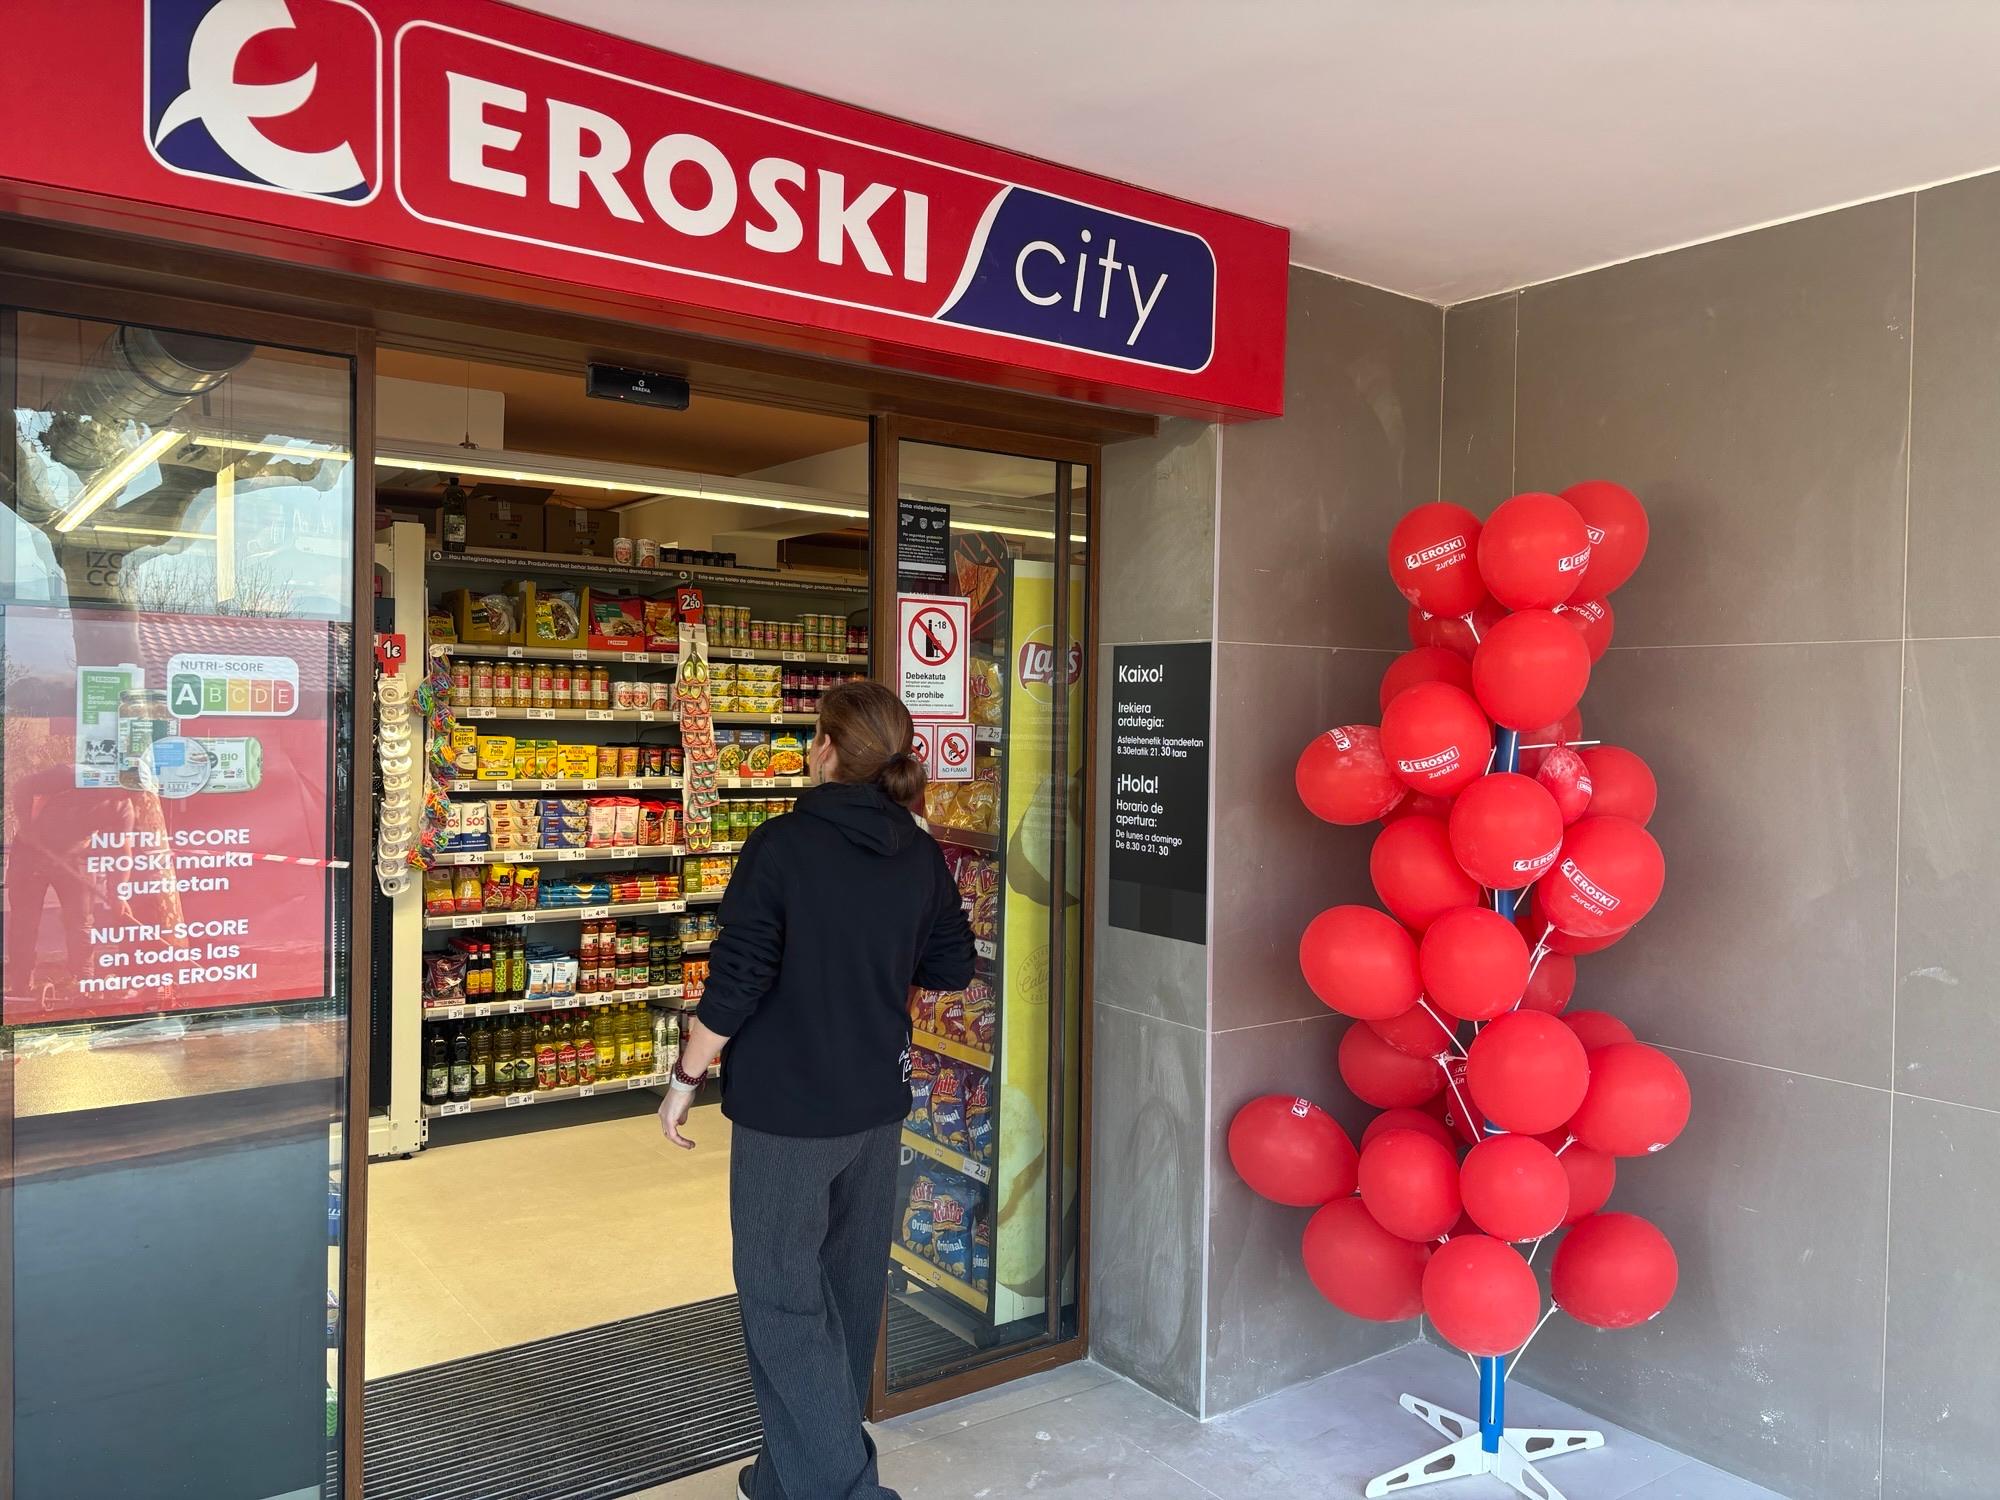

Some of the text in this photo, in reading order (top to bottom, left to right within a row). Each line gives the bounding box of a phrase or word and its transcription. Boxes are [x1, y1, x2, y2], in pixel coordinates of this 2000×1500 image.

[445, 70, 928, 283] EROSKI
[1015, 229, 1168, 345] city
[1420, 538, 1463, 561] EROSKI
[1435, 552, 1466, 572] zurekin
[934, 621, 947, 630] -18
[383, 639, 401, 658] 1€
[180, 661, 264, 672] NUTRI-SCORE
[1022, 644, 1079, 688] Las
[1119, 664, 1163, 682] Kaixo!
[906, 672, 946, 681] Debekatuta
[175, 684, 289, 705] A B C D E
[905, 690, 944, 700] Se prohibe
[1118, 702, 1151, 713] Irekiera
[1118, 716, 1164, 730] ordutegia:
[1117, 736, 1161, 745] Astelehenetik
[1172, 749, 1187, 758] tara
[1413, 750, 1456, 770] EROSKI
[1428, 762, 1459, 779] zurekin
[1117, 774, 1158, 794] ¡Hola!
[1116, 799, 1163, 814] Horario de
[447, 819, 459, 828] OS
[466, 817, 485, 826] SOS
[1116, 814, 1157, 827] apertura:
[91, 829, 250, 849] NUTRI-SCORE
[1116, 829, 1125, 838] De
[1126, 830, 1143, 840] lunes
[1151, 834, 1182, 847] domingo
[1116, 840, 1125, 849] De
[1126, 842, 1140, 850] 8.30
[87, 851, 253, 873] EROSKI marka
[117, 876, 229, 900] guztietan
[1573, 873, 1615, 908] EROSKI
[1570, 893, 1604, 917] zurekin
[90, 919, 248, 944] NUTRI-SCORE
[99, 943, 240, 967] en todas las
[80, 963, 257, 992] marcas EROSKI
[912, 1219, 933, 1233] Origin
